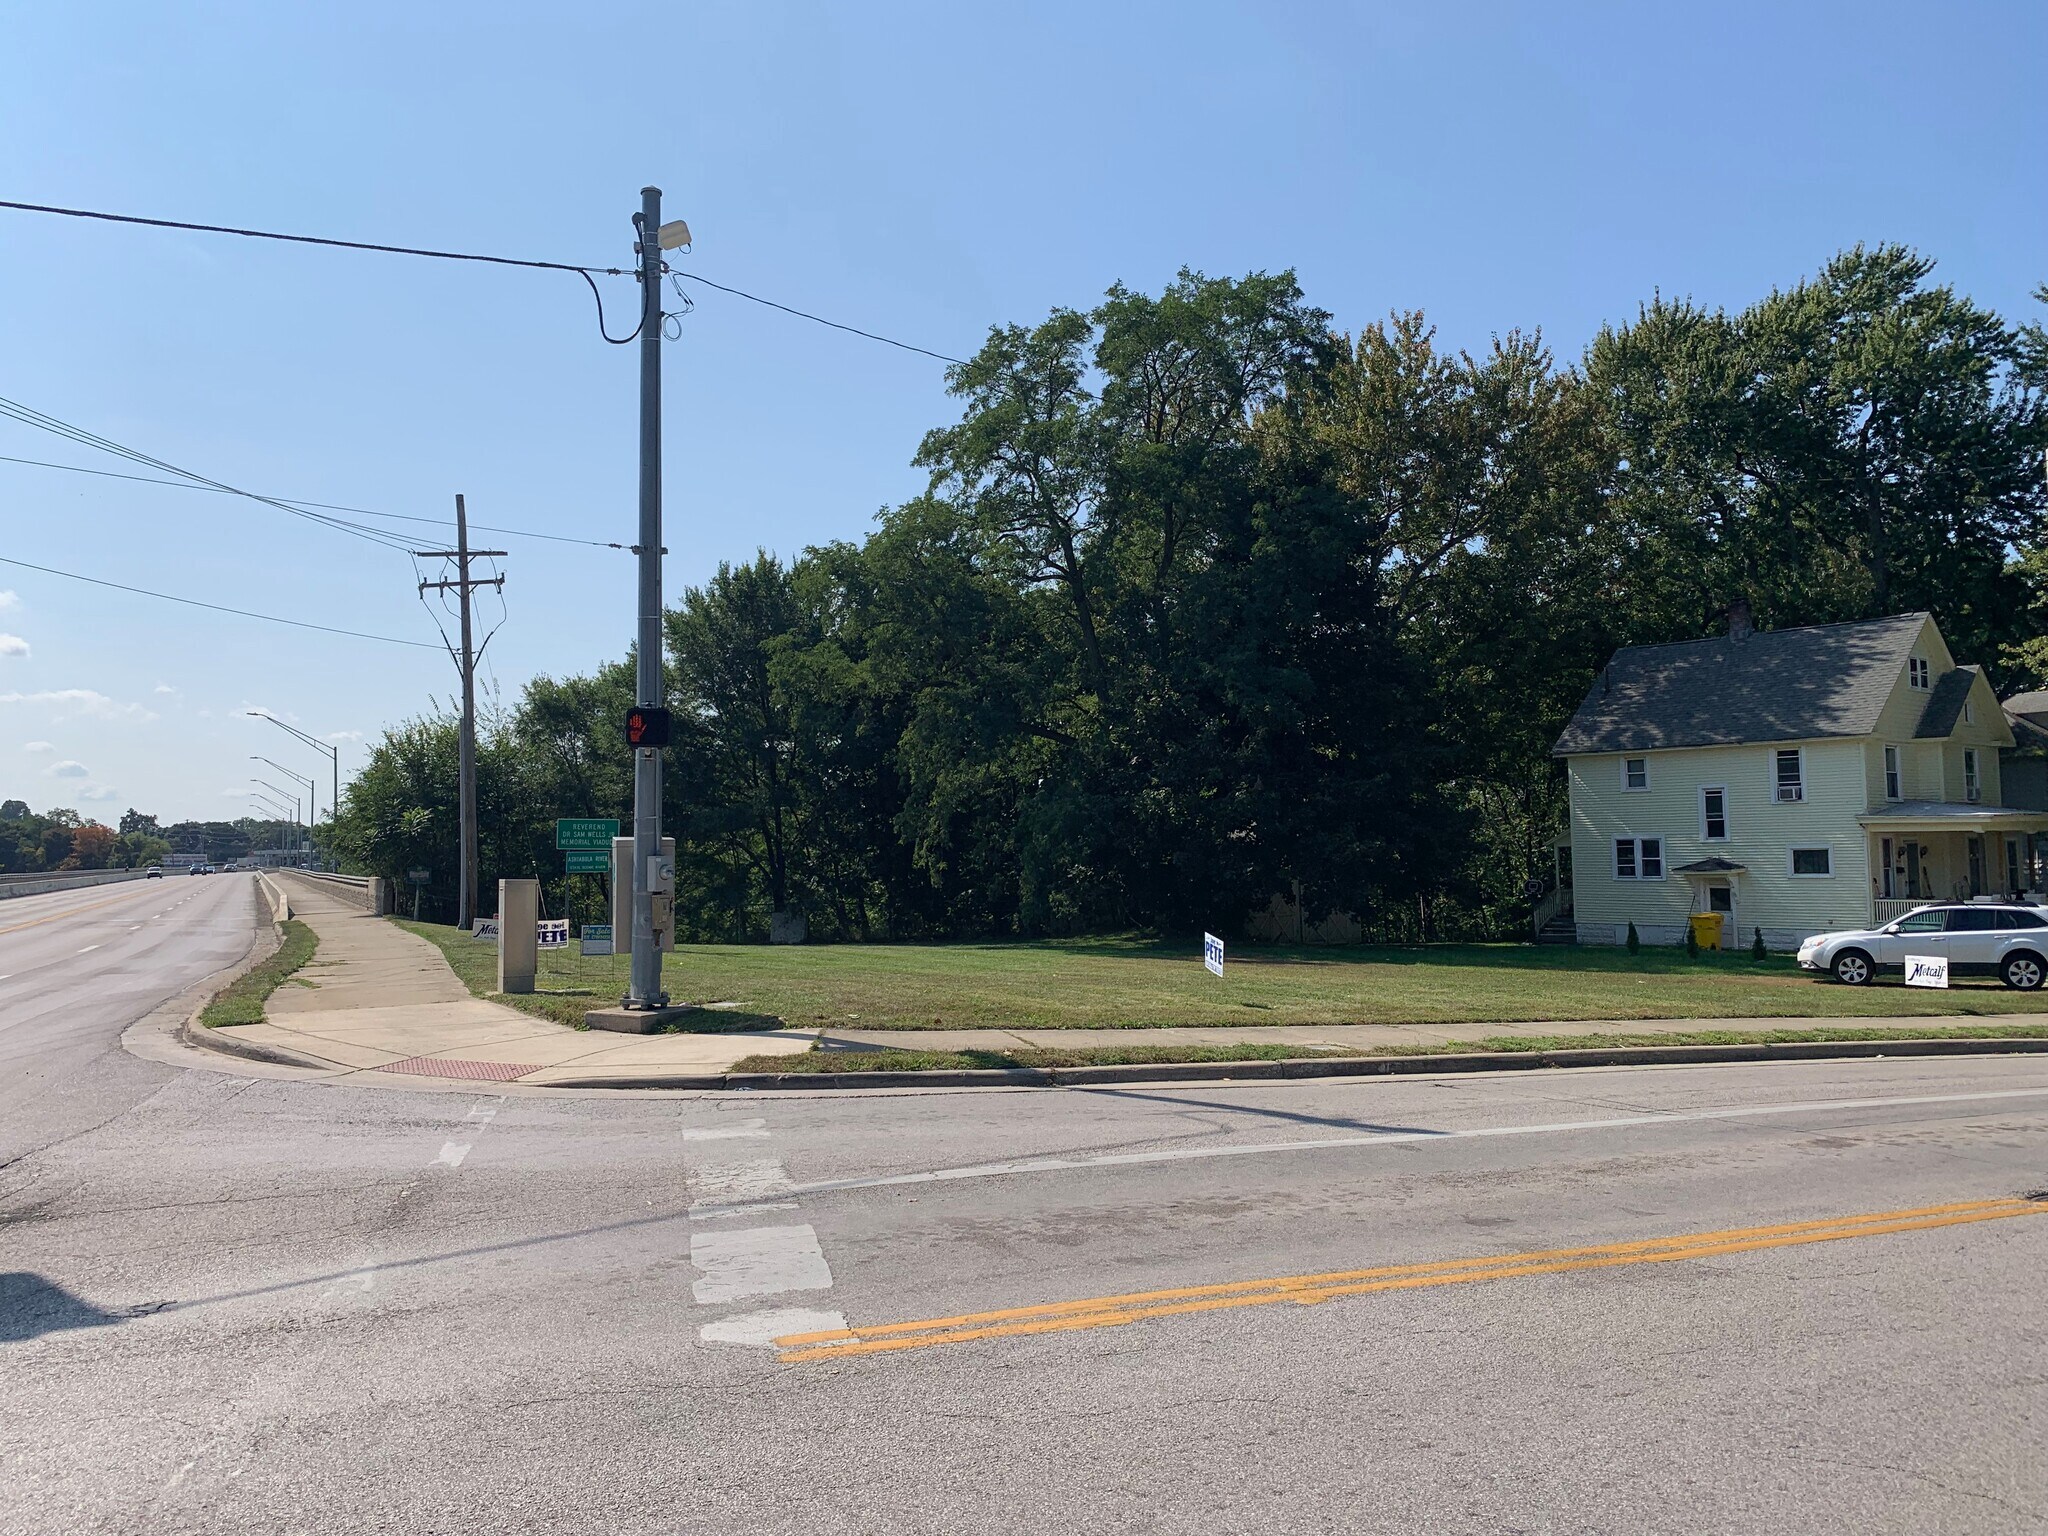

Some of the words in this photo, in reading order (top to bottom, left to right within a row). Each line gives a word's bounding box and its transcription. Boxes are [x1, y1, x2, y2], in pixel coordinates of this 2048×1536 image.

[473, 923, 498, 938] Metc
[1206, 940, 1222, 966] PETE
[1907, 963, 1947, 981] Metcalf
